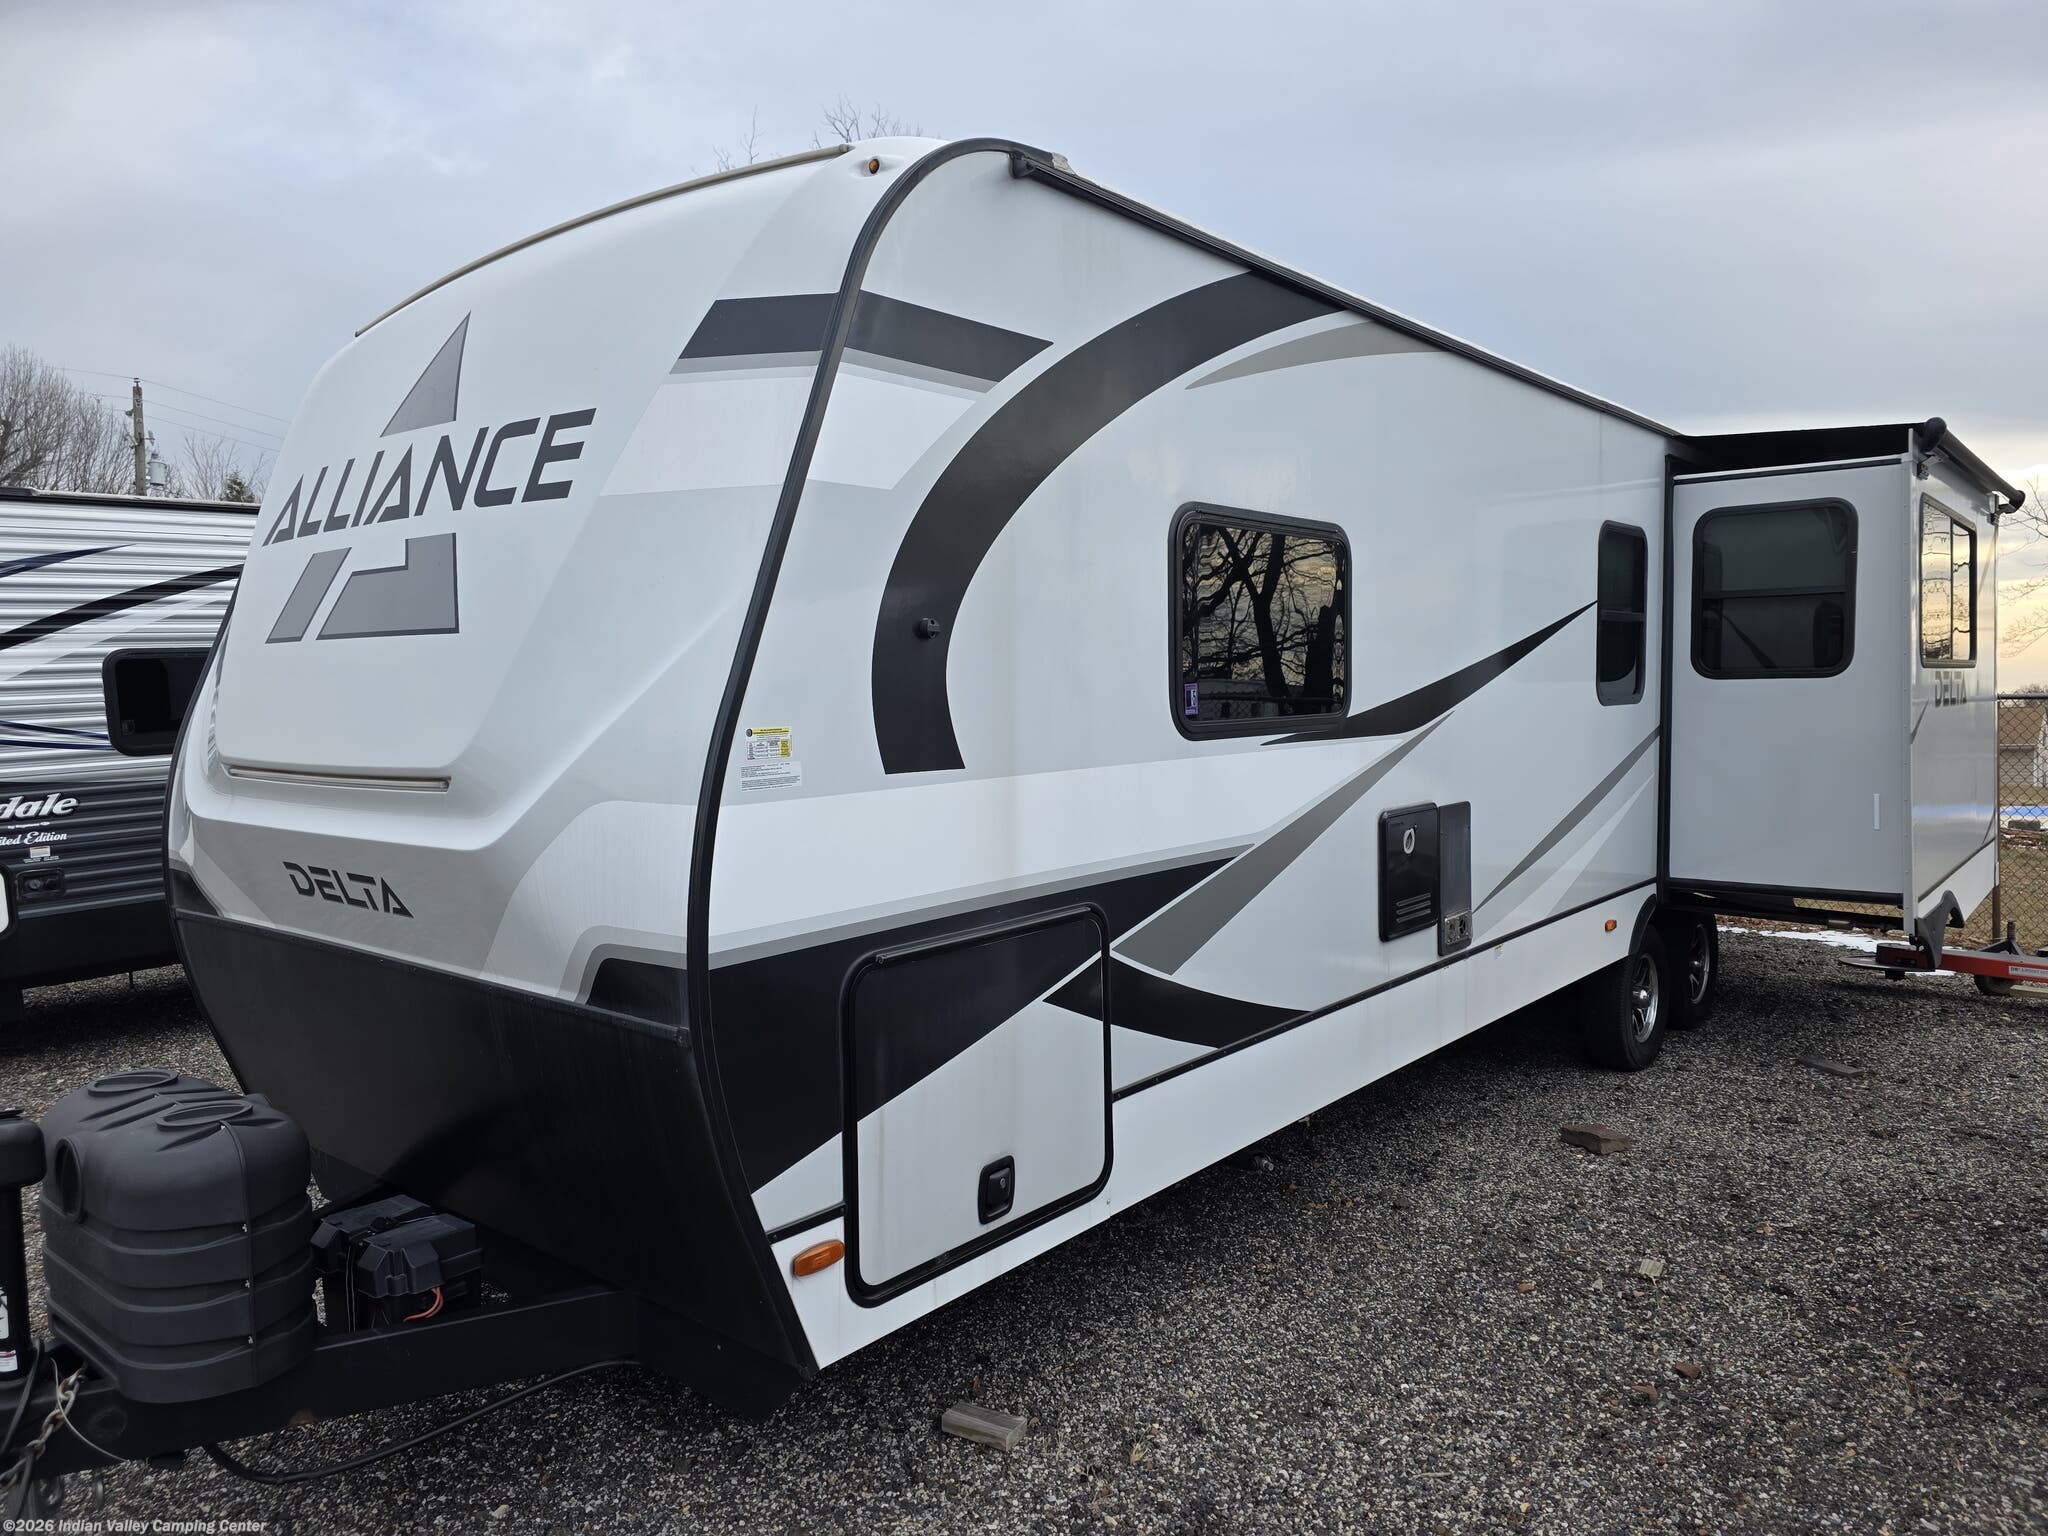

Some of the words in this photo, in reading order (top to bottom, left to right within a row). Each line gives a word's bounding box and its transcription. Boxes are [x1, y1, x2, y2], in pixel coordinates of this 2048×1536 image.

[262, 407, 597, 547] ALLIANCE
[1935, 670, 1967, 708] DELTA
[23, 831, 68, 845] Edition
[282, 861, 414, 919] DELTA
